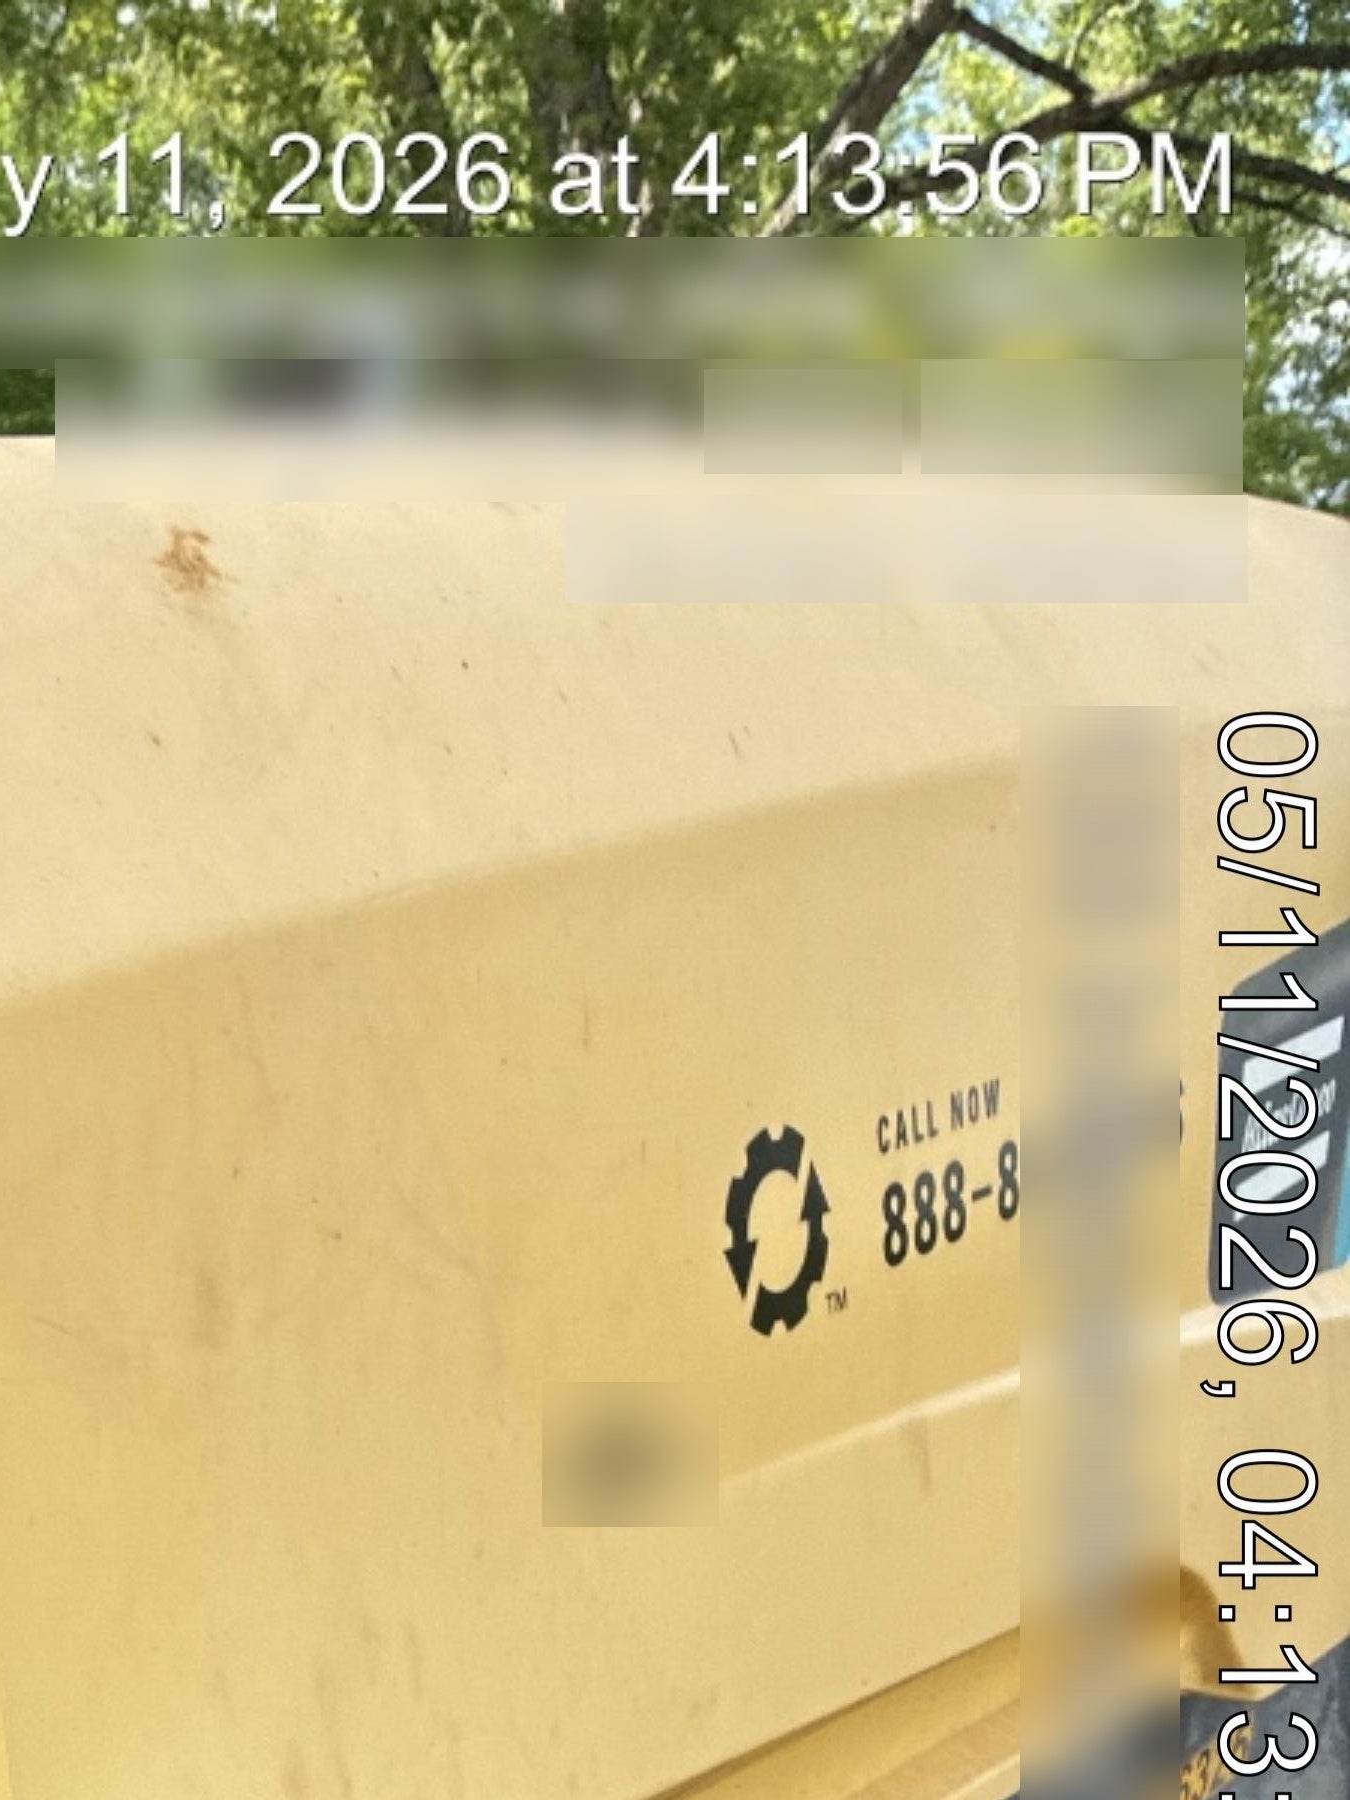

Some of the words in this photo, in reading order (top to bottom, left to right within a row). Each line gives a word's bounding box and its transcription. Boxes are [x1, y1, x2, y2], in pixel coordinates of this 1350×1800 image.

[876, 1100, 940, 1156] CALL
[950, 1077, 1001, 1131] NOW
[882, 1139, 1020, 1268] 888-8
